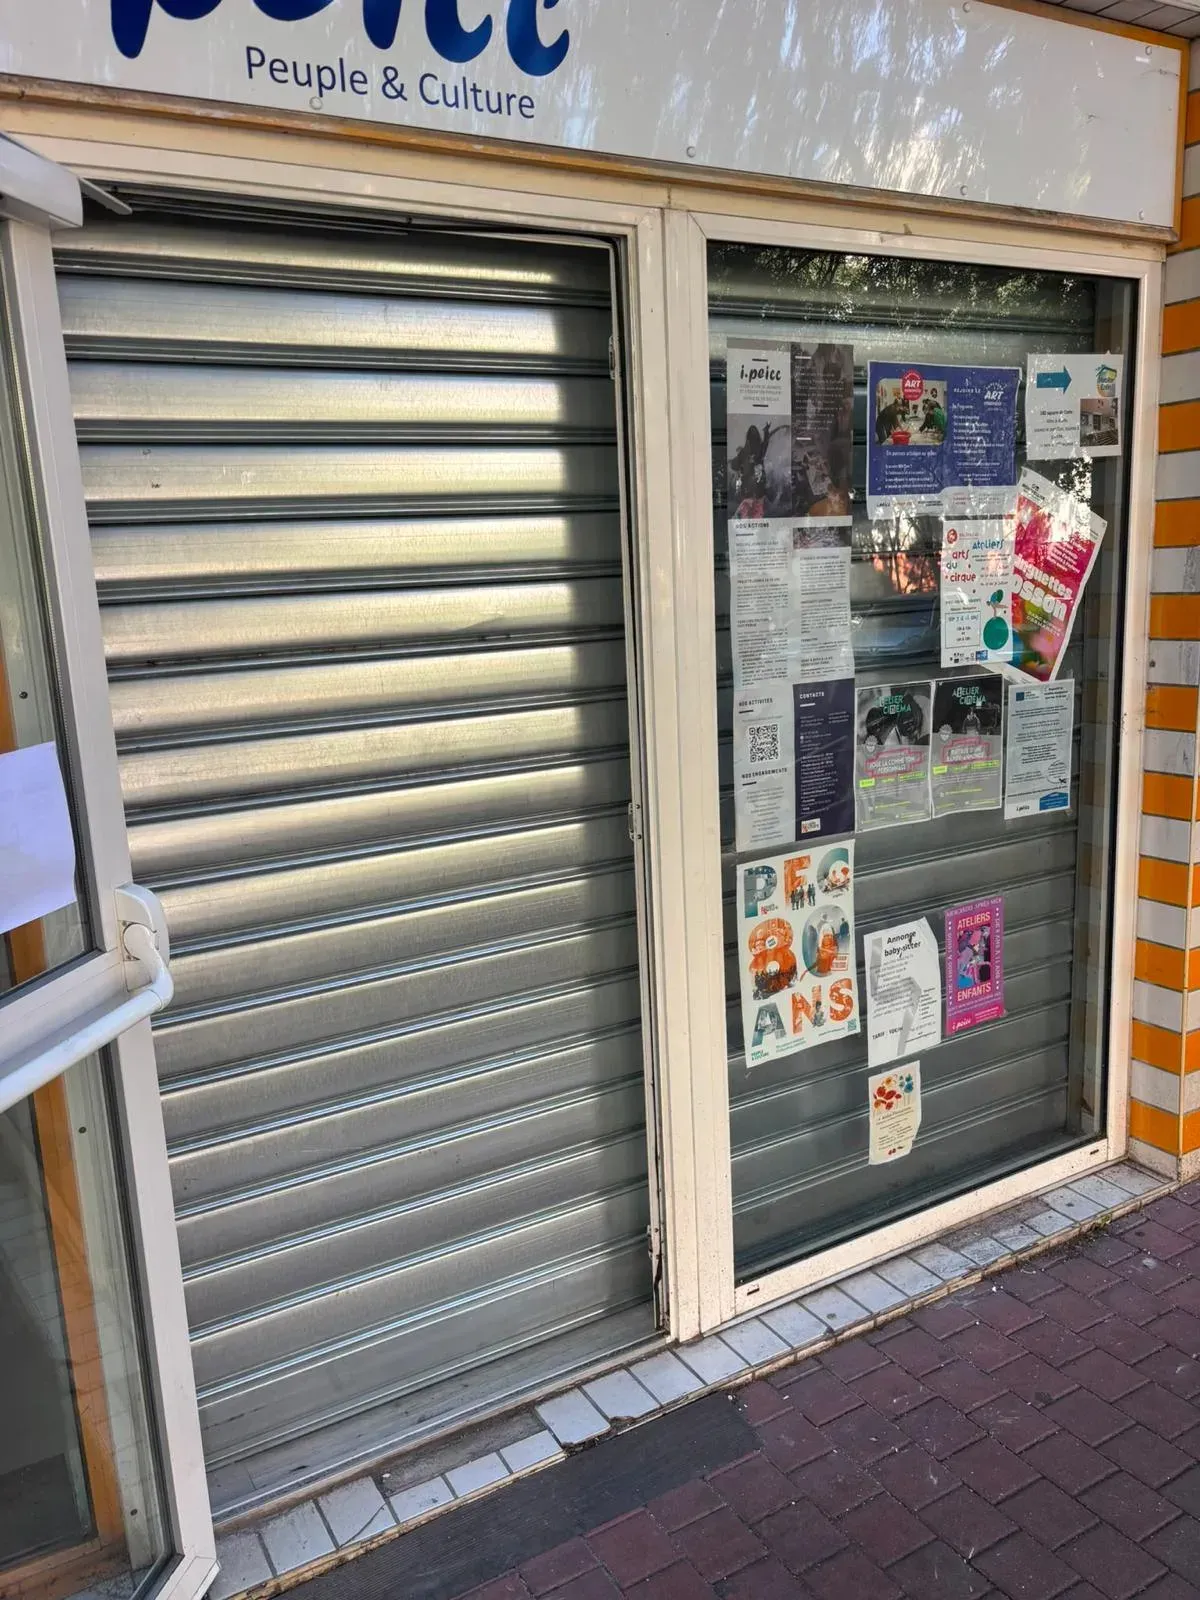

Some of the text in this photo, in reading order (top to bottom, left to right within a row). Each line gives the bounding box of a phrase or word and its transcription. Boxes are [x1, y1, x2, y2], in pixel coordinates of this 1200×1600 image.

[245, 46, 536, 119] Peuple & Culture
[740, 364, 782, 383] i.peicc
[904, 379, 921, 388] ART
[984, 390, 1004, 400] ART
[972, 539, 1004, 550] ateliers
[952, 549, 970, 560] arts
[946, 561, 958, 569] du
[949, 573, 976, 582] cirque
[800, 691, 825, 699] CONTACTS
[952, 687, 980, 698] ATELIER
[751, 768, 788, 778] ENGAGEMENTS
[957, 911, 991, 930] ATELIERS
[886, 931, 917, 944] Annonce
[748, 904, 851, 1000] 80
[884, 940, 922, 957] baby-sitter
[957, 982, 992, 1001] ENFANTS
[751, 978, 854, 1047] ANS
